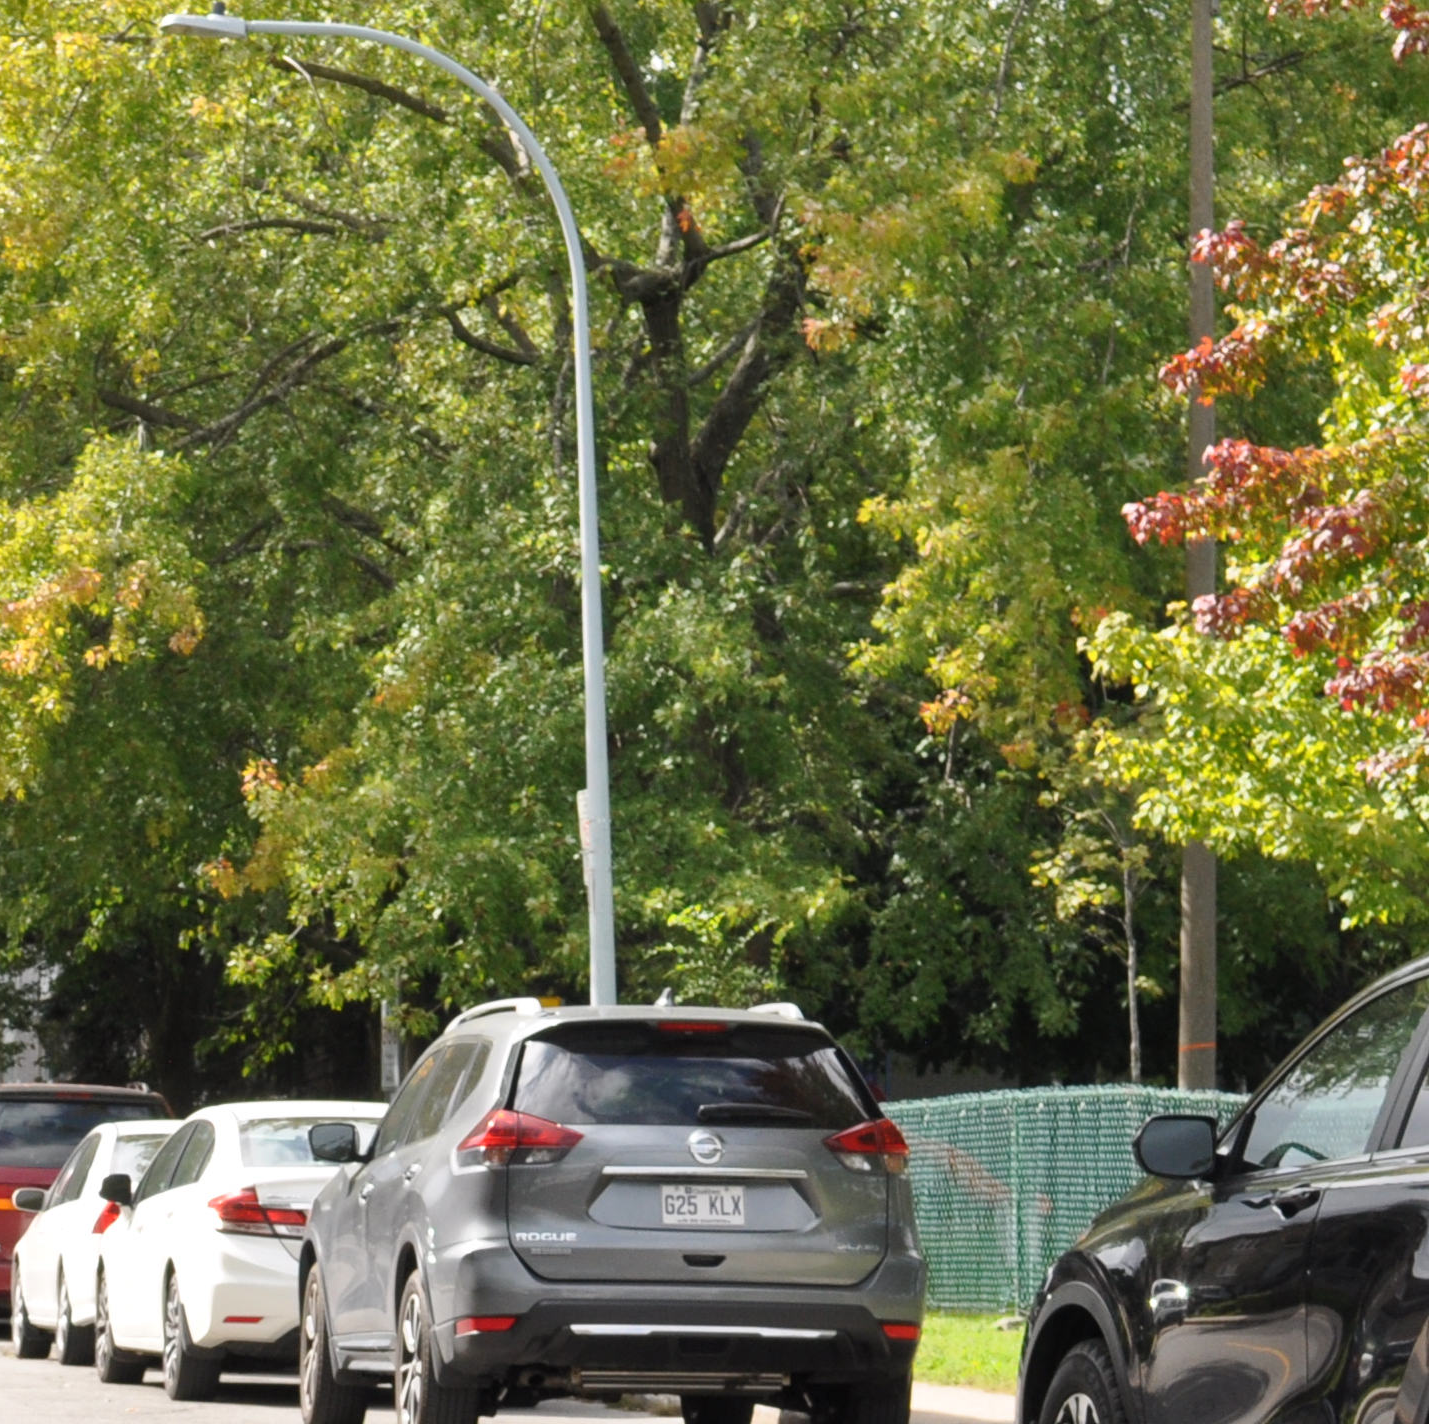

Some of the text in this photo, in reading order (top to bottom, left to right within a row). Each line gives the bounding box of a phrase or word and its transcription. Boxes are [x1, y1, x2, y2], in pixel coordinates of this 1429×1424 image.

[664, 1194, 742, 1216] G25 KLX
[515, 1231, 577, 1242] ROGUE
